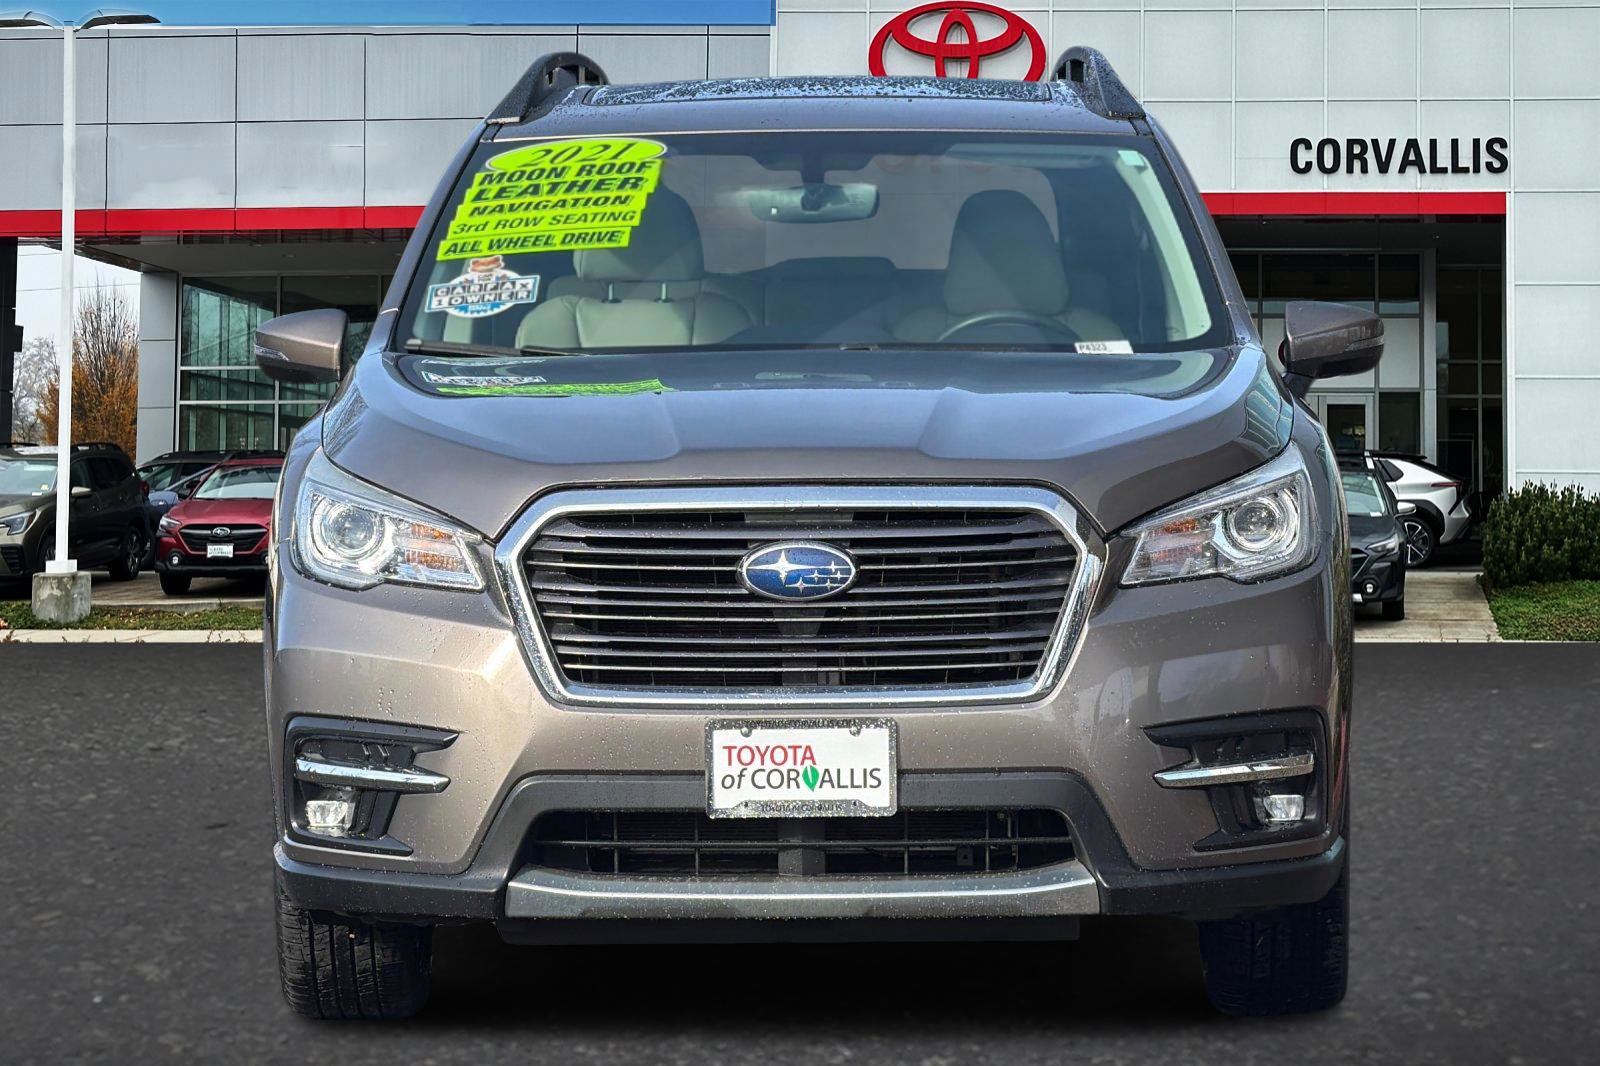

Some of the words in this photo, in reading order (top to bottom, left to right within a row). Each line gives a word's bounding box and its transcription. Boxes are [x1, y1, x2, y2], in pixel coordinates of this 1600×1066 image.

[517, 142, 639, 168] 2021
[1289, 137, 1510, 175] CORVALLIS
[478, 166, 571, 187] MOON
[576, 161, 656, 178] ROOF
[470, 176, 648, 202] LEATHER
[469, 195, 633, 217] NAVIGATION
[453, 220, 486, 235] 3rd
[492, 215, 545, 231] ROW
[548, 210, 637, 226] SEATING
[444, 240, 483, 256] ALL
[487, 233, 557, 251] WHEEL
[560, 230, 623, 246] DRIVE
[436, 281, 530, 297] CARFAX
[722, 744, 817, 767] TOYOTA
[721, 768, 748, 790] of
[751, 766, 883, 791] CORVALLIS
